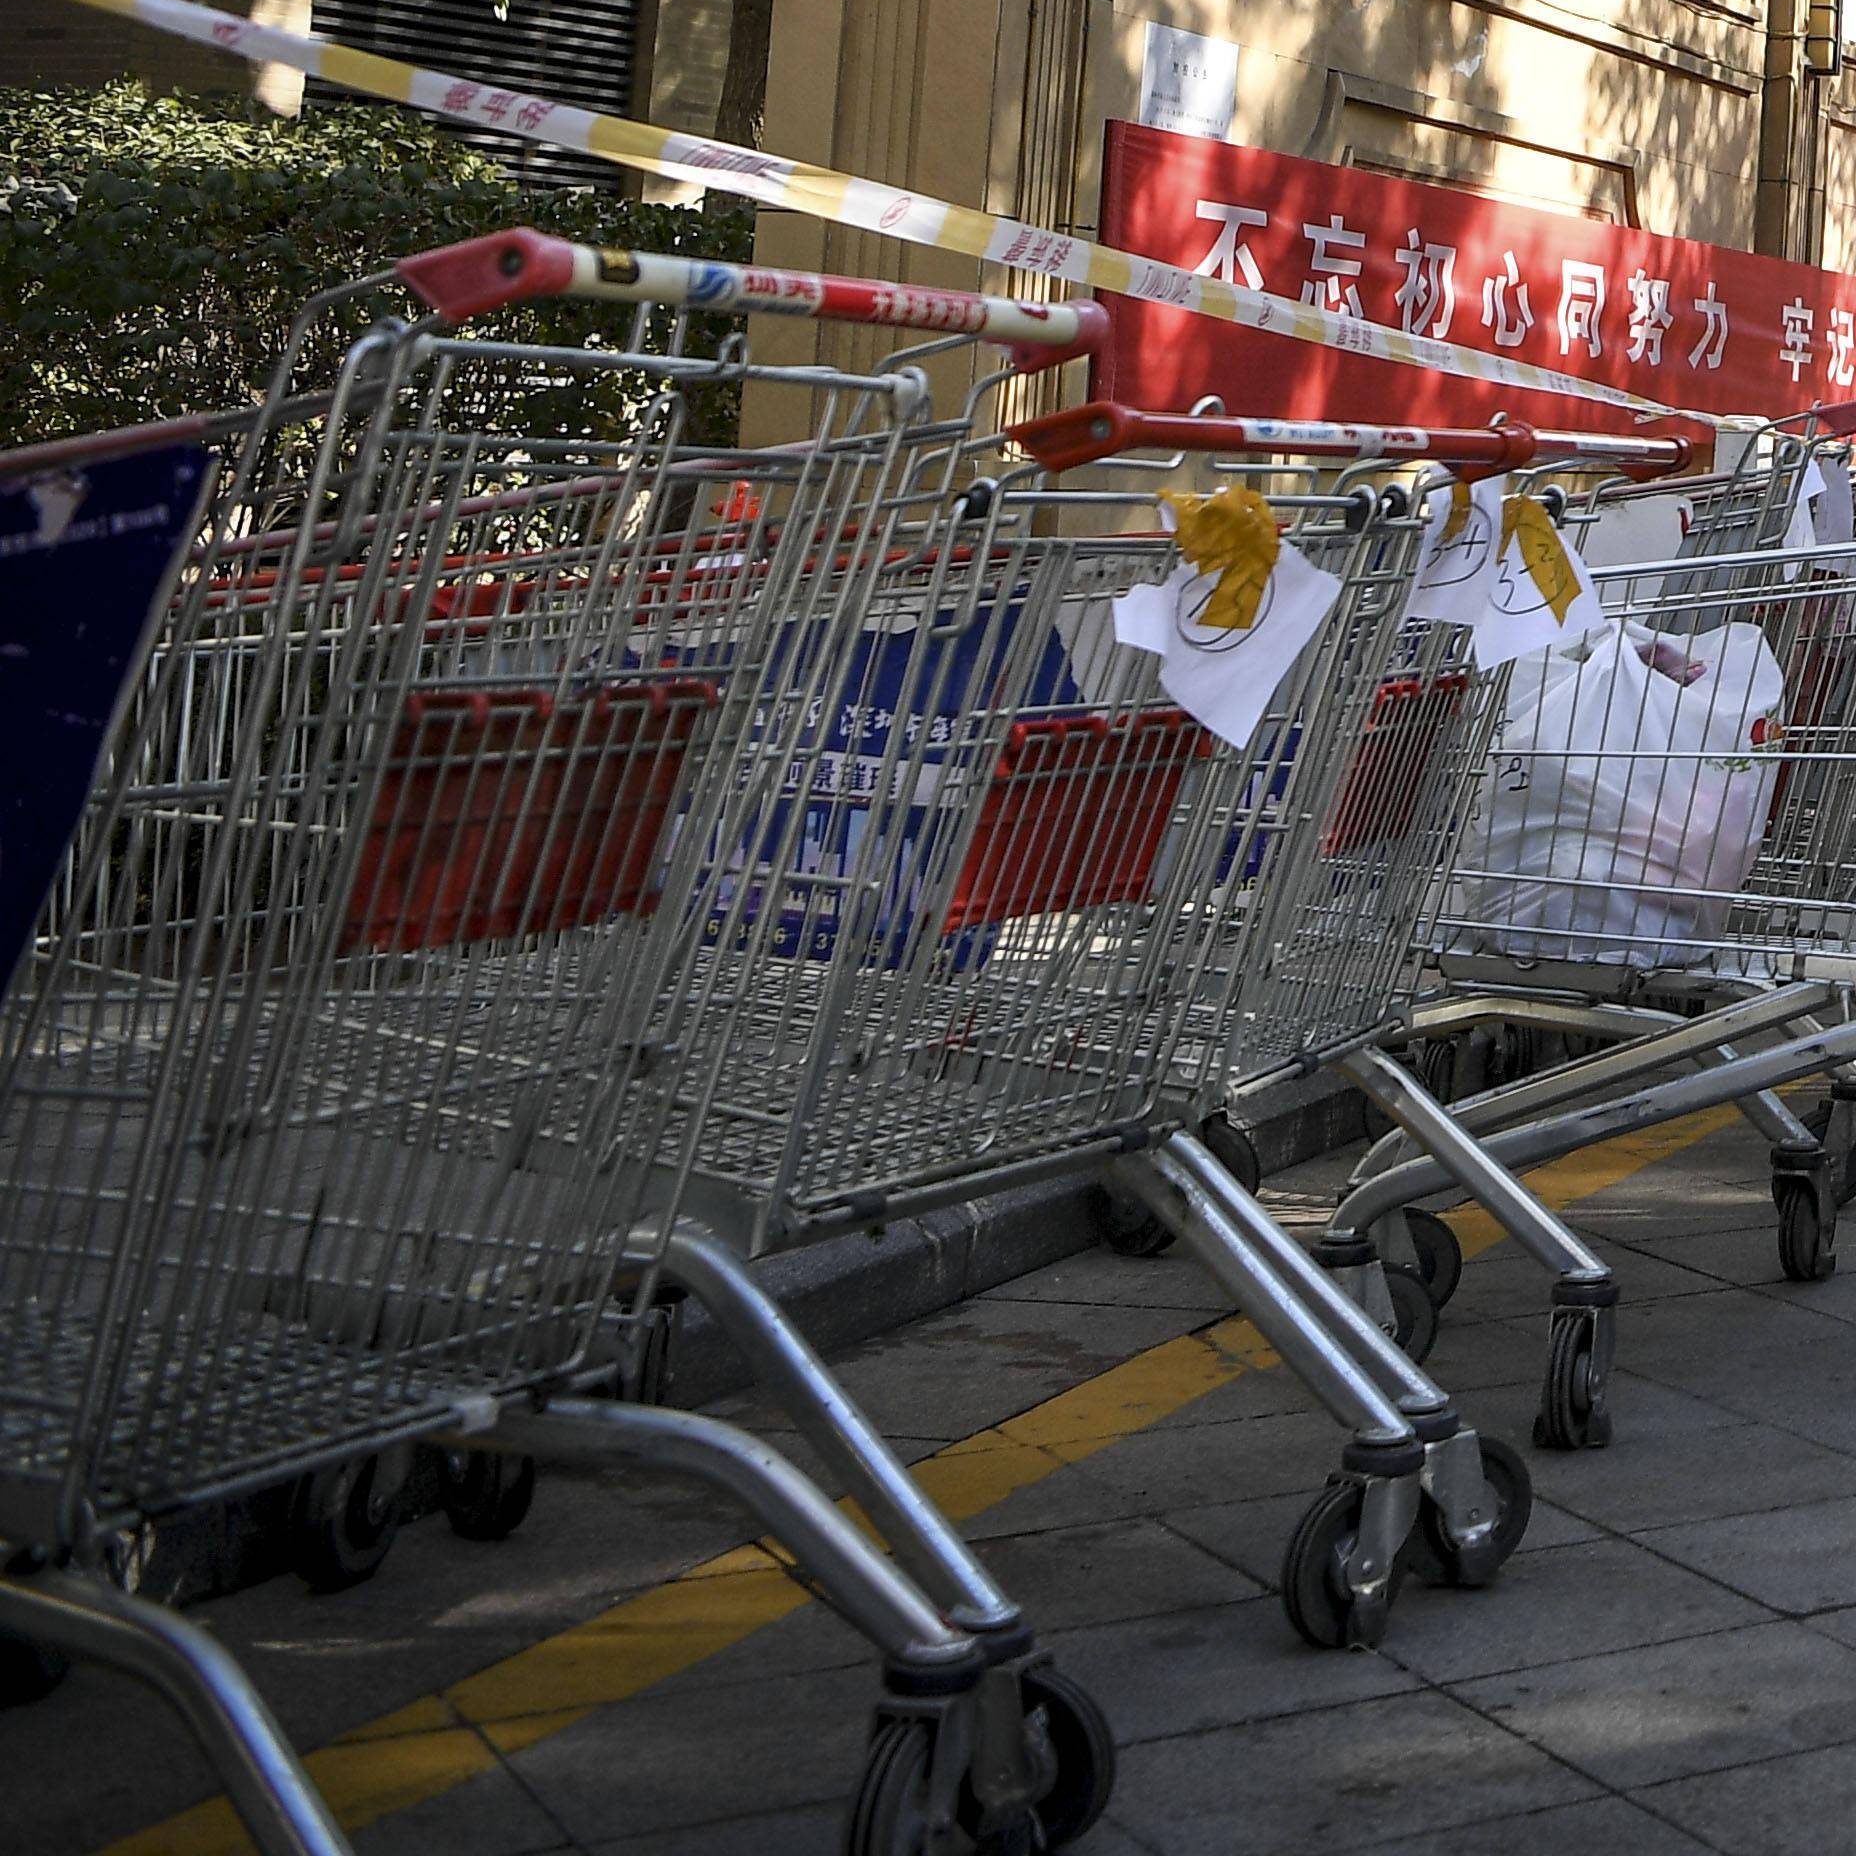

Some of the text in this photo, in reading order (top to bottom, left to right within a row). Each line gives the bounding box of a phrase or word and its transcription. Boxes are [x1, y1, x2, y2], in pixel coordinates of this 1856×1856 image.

[1191, 198, 1731, 372] 不忘初心同努力
